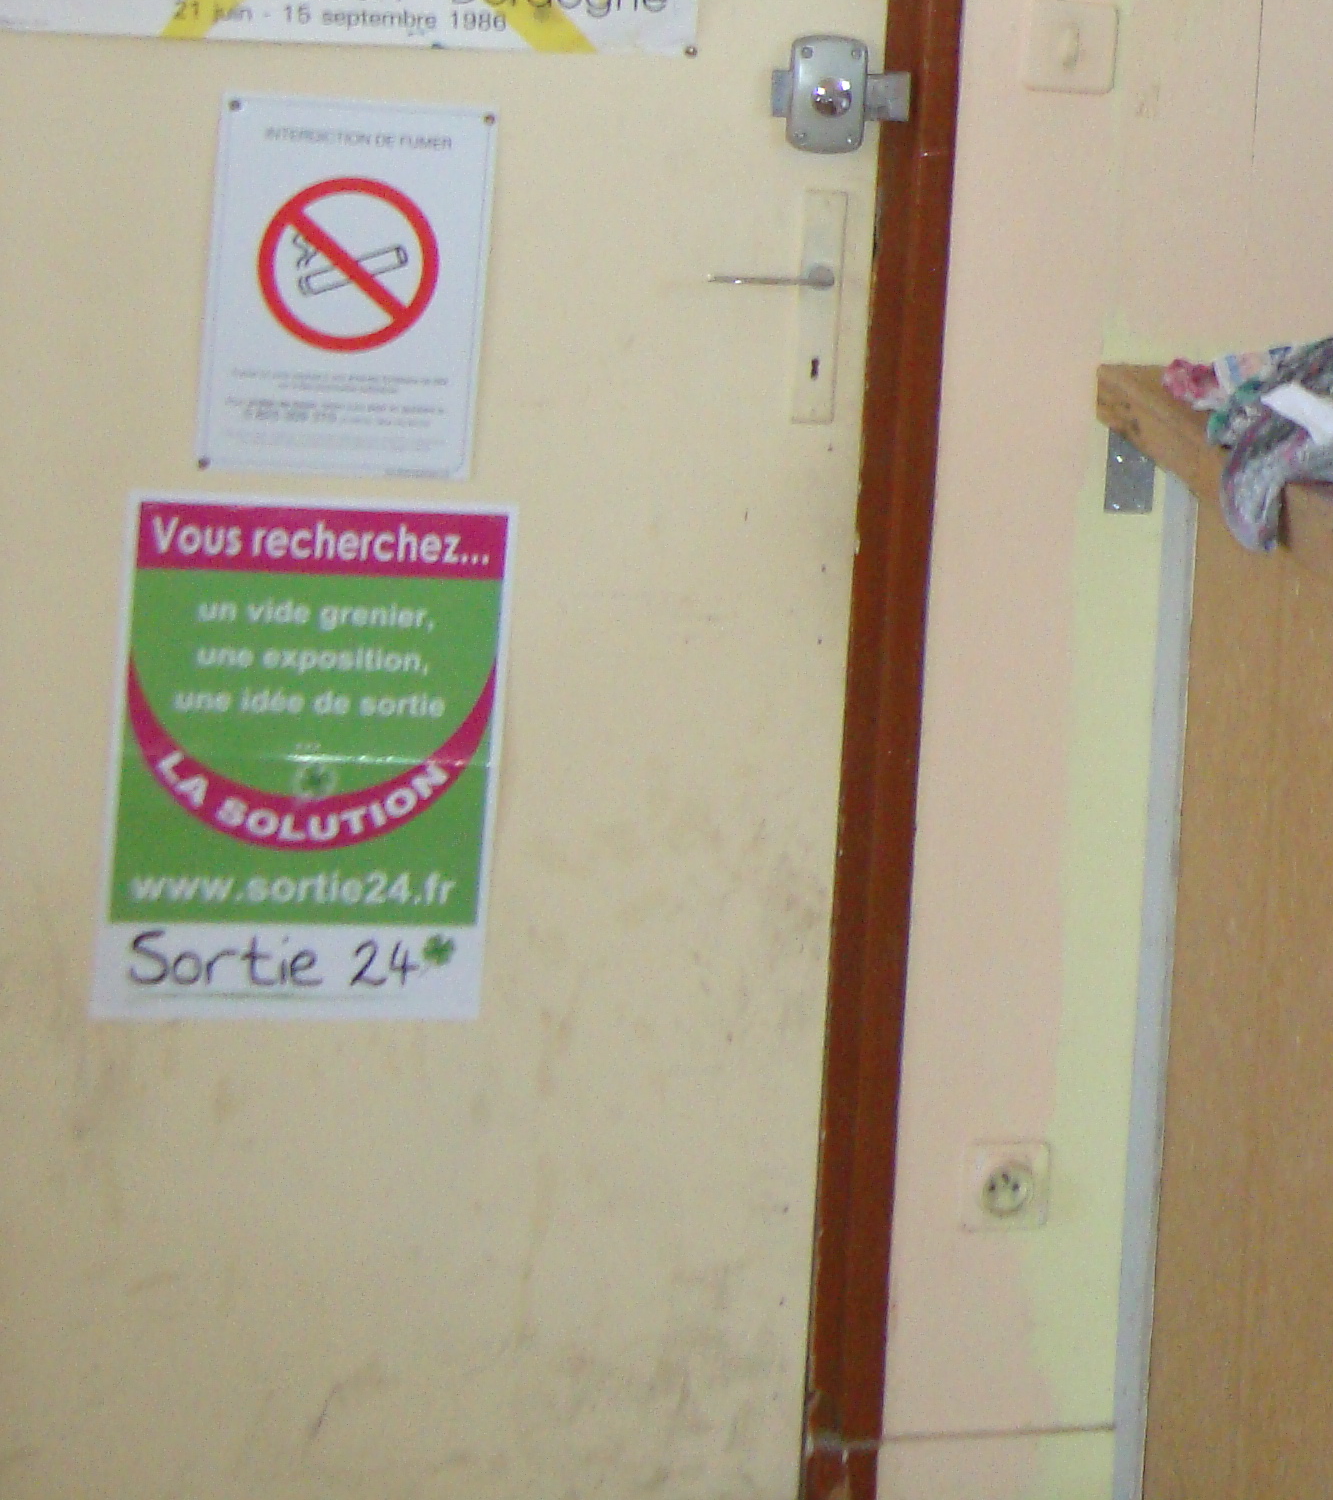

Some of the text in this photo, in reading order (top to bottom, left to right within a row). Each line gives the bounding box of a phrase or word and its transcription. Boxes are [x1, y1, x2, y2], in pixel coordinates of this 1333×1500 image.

[173, 0, 200, 21] 21
[322, 7, 437, 33] septembre
[450, 10, 508, 33] 1986
[151, 515, 491, 566] Vous recherchez...
[197, 599, 436, 632] un vide grenier,
[196, 647, 430, 677] une exposition,
[171, 686, 447, 719] une idée de sortie
[156, 749, 451, 843] LA SOLUTION
[130, 869, 458, 906] www.sortie24.fr
[128, 930, 420, 989] Sortie 24
